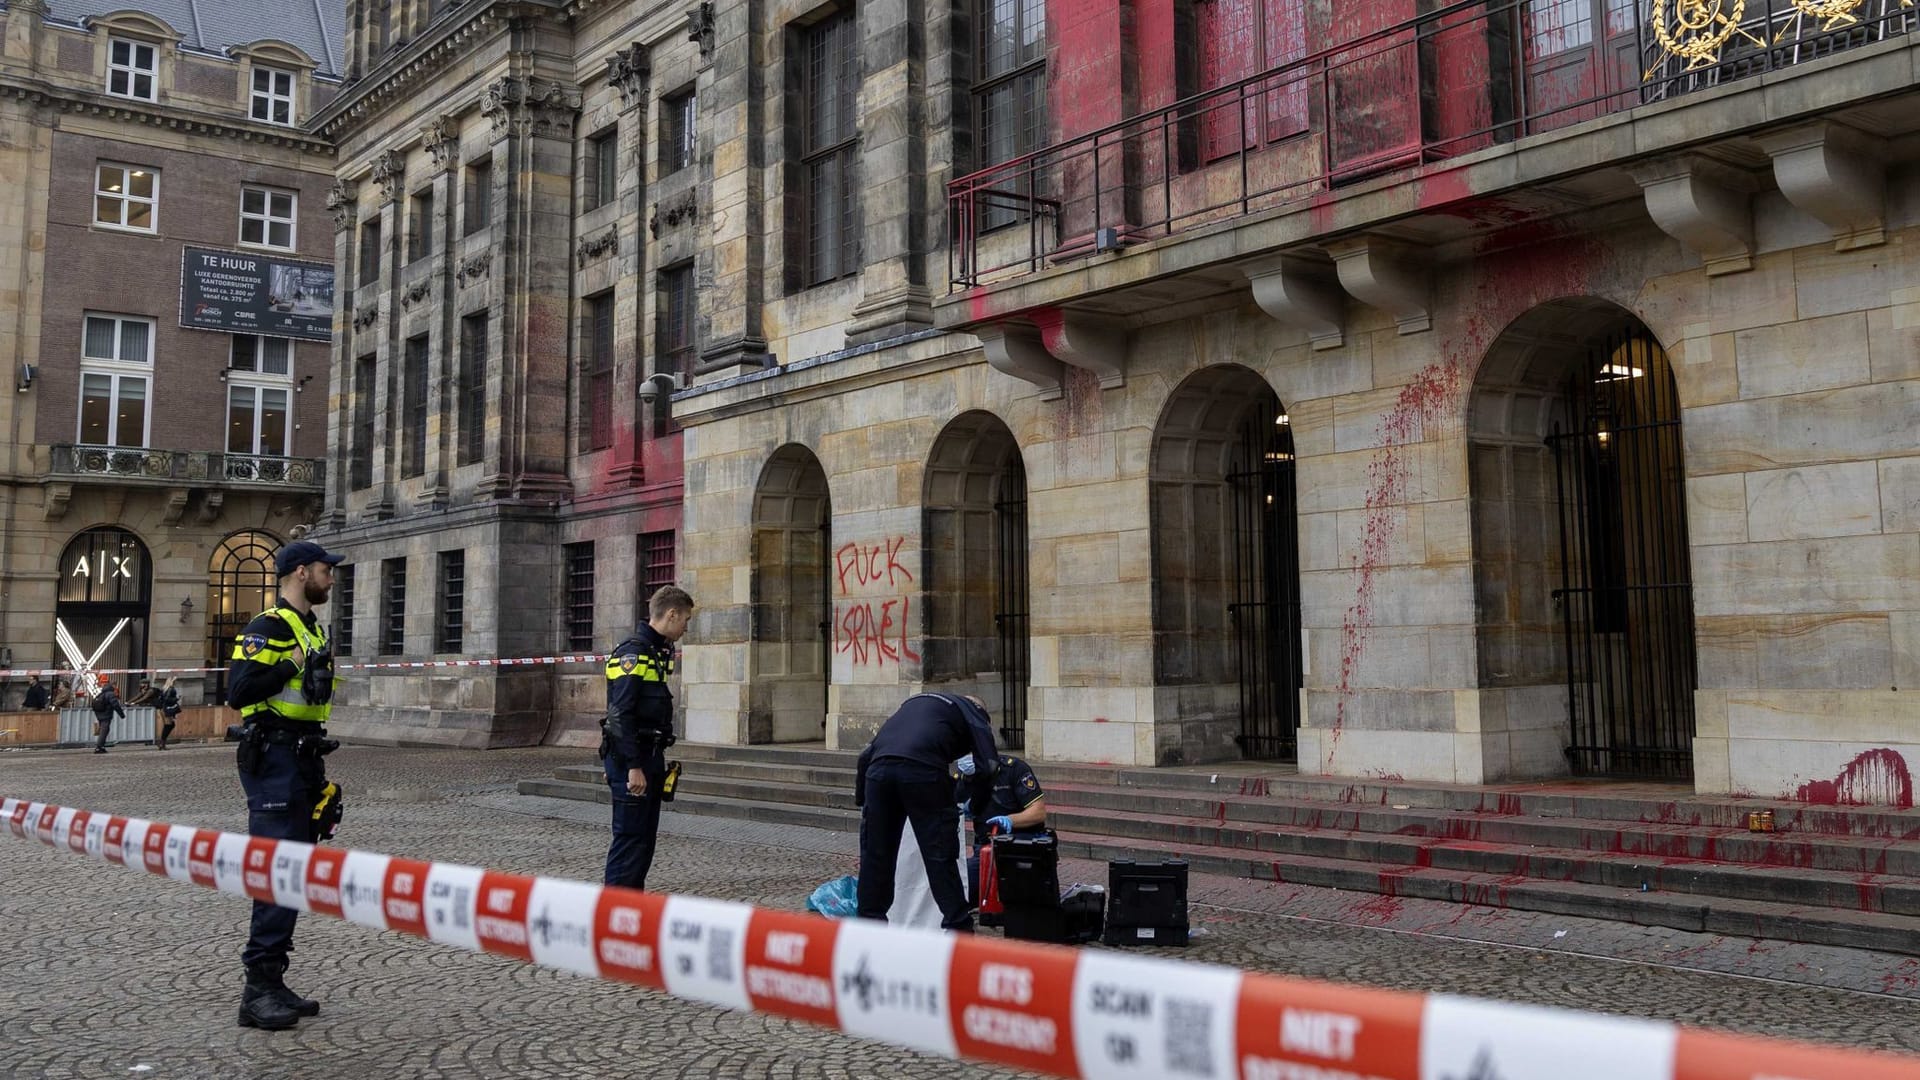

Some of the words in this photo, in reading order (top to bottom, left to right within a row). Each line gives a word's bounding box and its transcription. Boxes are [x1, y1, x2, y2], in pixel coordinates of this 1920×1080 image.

[202, 255, 218, 267] TE
[221, 257, 256, 272] HUUR
[194, 270, 211, 278] LUXE
[212, 272, 262, 284] GERENOVEERDE
[200, 285, 218, 293] Totaal
[201, 277, 255, 290] KANTOORRUIMTE
[234, 311, 256, 319] CBRE
[837, 536, 912, 594] FUCK
[835, 596, 921, 666] ISRAEL
[979, 961, 1034, 1006] IETS
[1089, 983, 1153, 1018] SCAN
[1279, 1006, 1362, 1061] NIET
